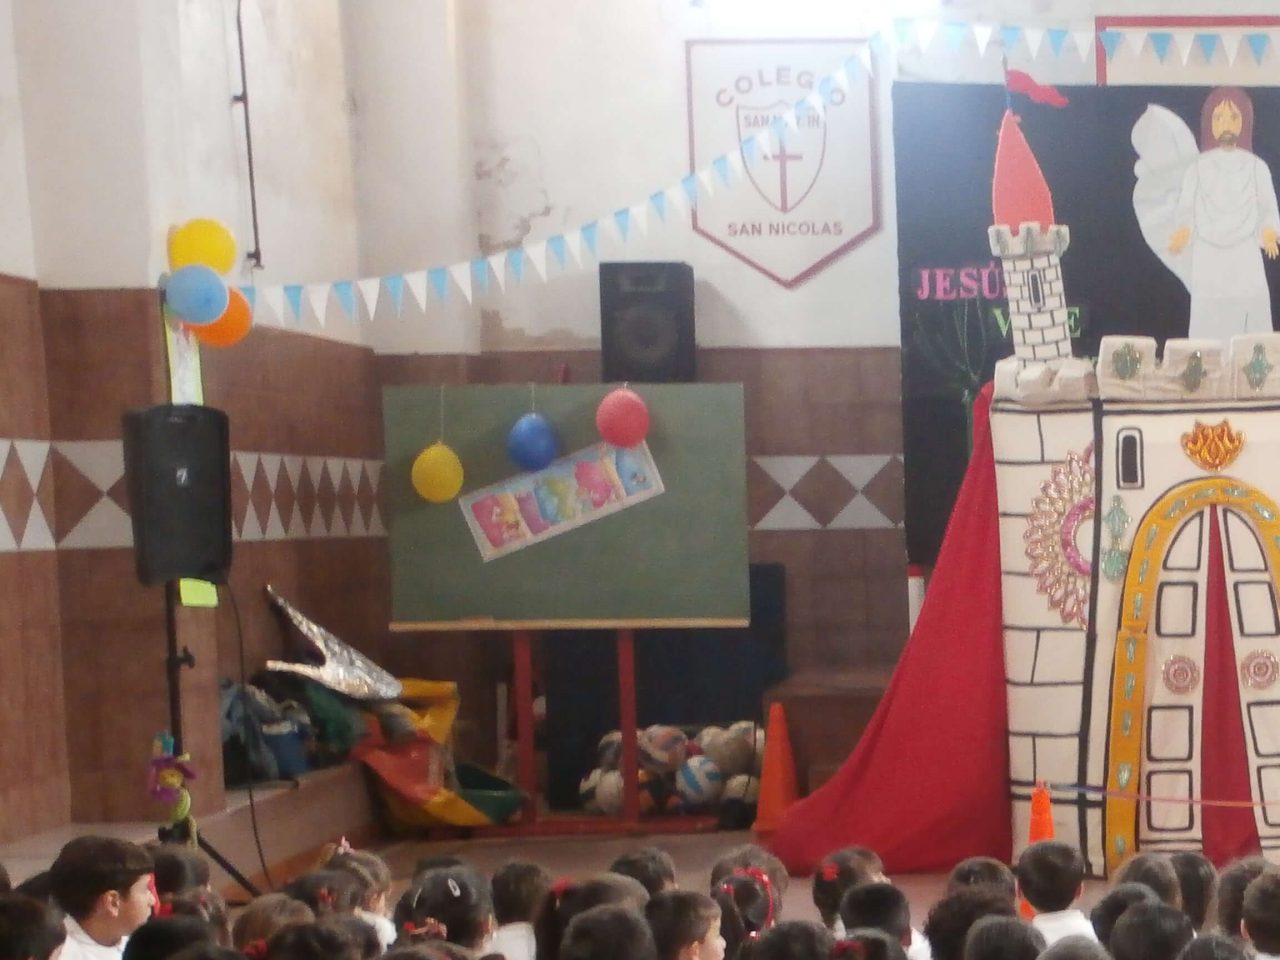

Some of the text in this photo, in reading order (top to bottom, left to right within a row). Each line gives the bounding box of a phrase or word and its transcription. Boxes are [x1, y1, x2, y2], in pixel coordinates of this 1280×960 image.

[715, 66, 845, 107] COLEGO
[743, 113, 768, 129] SAN
[728, 222, 843, 236] SAN NICOLAS
[917, 261, 1007, 300] JESÚ
